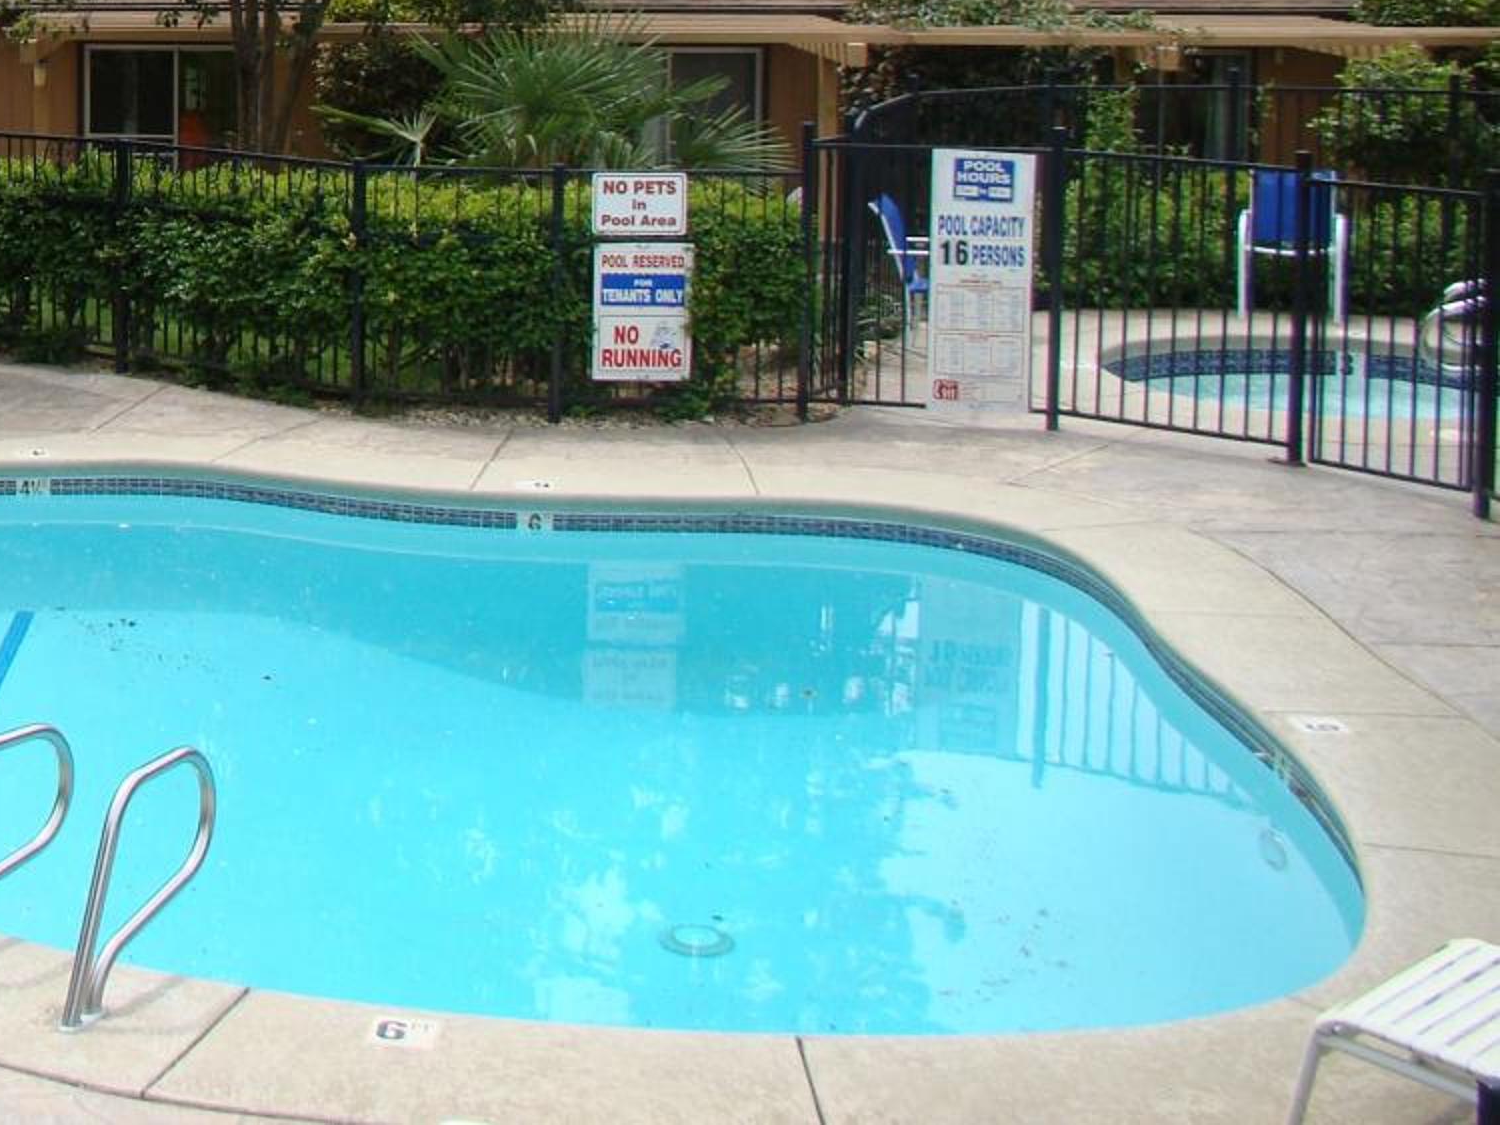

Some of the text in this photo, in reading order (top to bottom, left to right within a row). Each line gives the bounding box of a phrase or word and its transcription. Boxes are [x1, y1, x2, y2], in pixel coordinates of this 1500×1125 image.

[963, 160, 1005, 172] POOL
[957, 172, 1011, 184] HOURS
[603, 181, 677, 194] NO PETS
[631, 199, 647, 210] in
[601, 215, 677, 226] Pool Area
[938, 215, 1025, 237] POOL CAPACITY
[941, 240, 1025, 267] 16 PERSONS
[602, 255, 685, 268] POOL RESERVED
[603, 288, 683, 303] TENANTS ONLY
[614, 325, 639, 344] NO
[602, 349, 682, 368] RUNNING
[376, 1020, 407, 1040] 6
